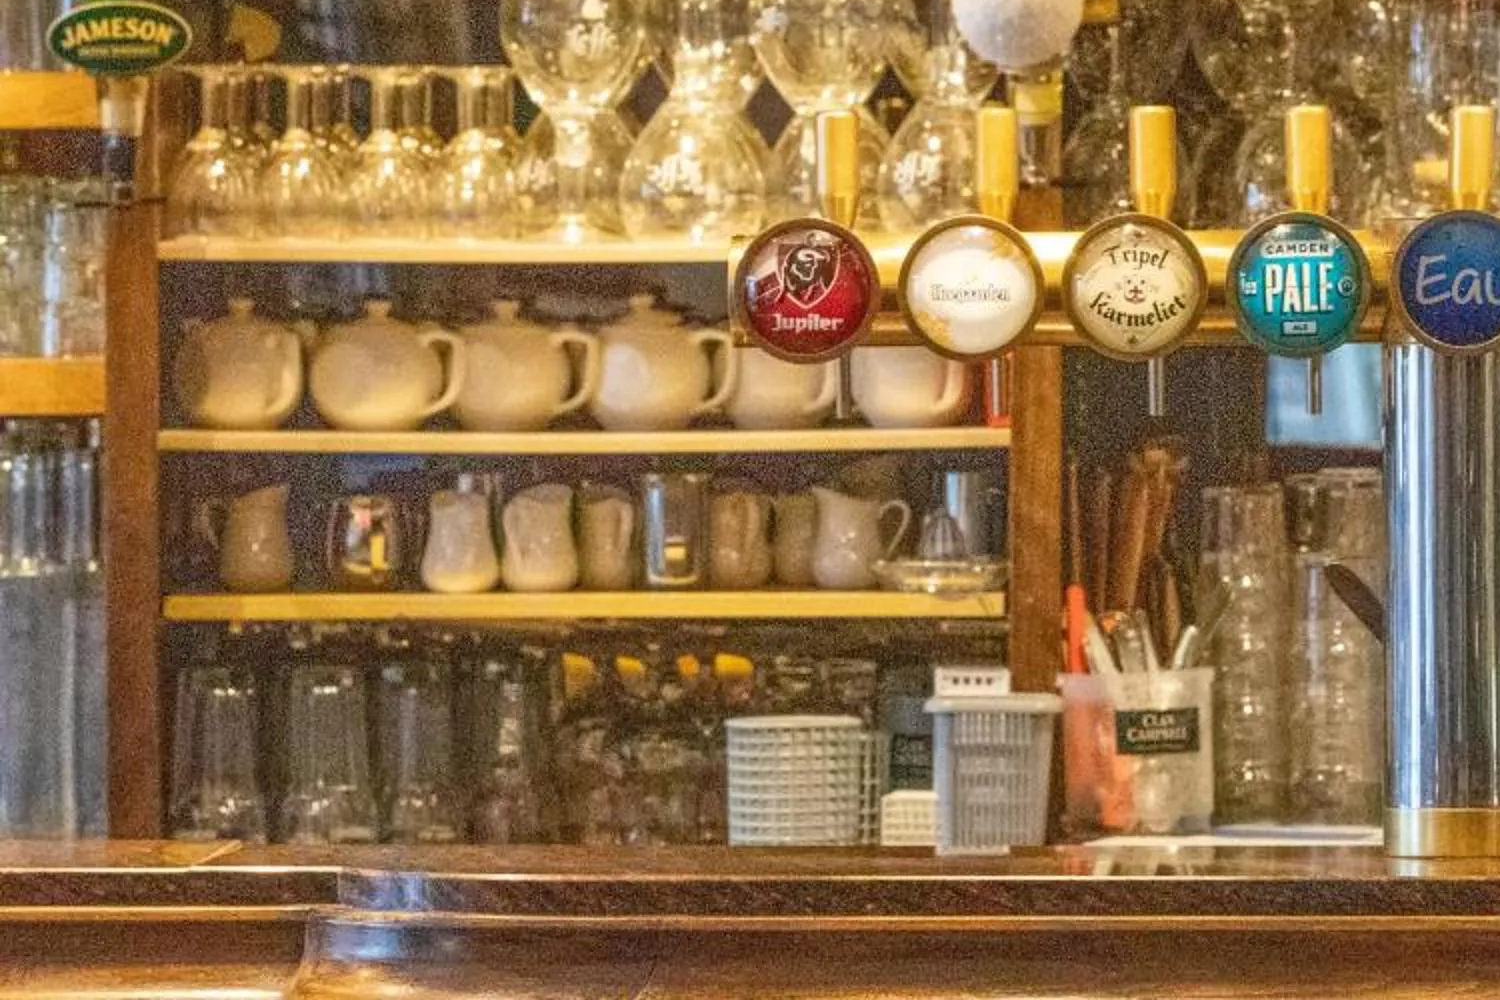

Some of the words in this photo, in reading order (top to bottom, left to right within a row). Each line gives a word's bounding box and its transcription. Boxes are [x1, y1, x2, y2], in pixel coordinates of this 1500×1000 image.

[62, 16, 174, 49] JAMESON
[1102, 244, 1169, 270] Tripel
[1265, 243, 1330, 255] CAMDEN
[1264, 262, 1335, 313] PALE
[771, 313, 844, 334] Jupiler
[1089, 291, 1186, 327] Karmeliet
